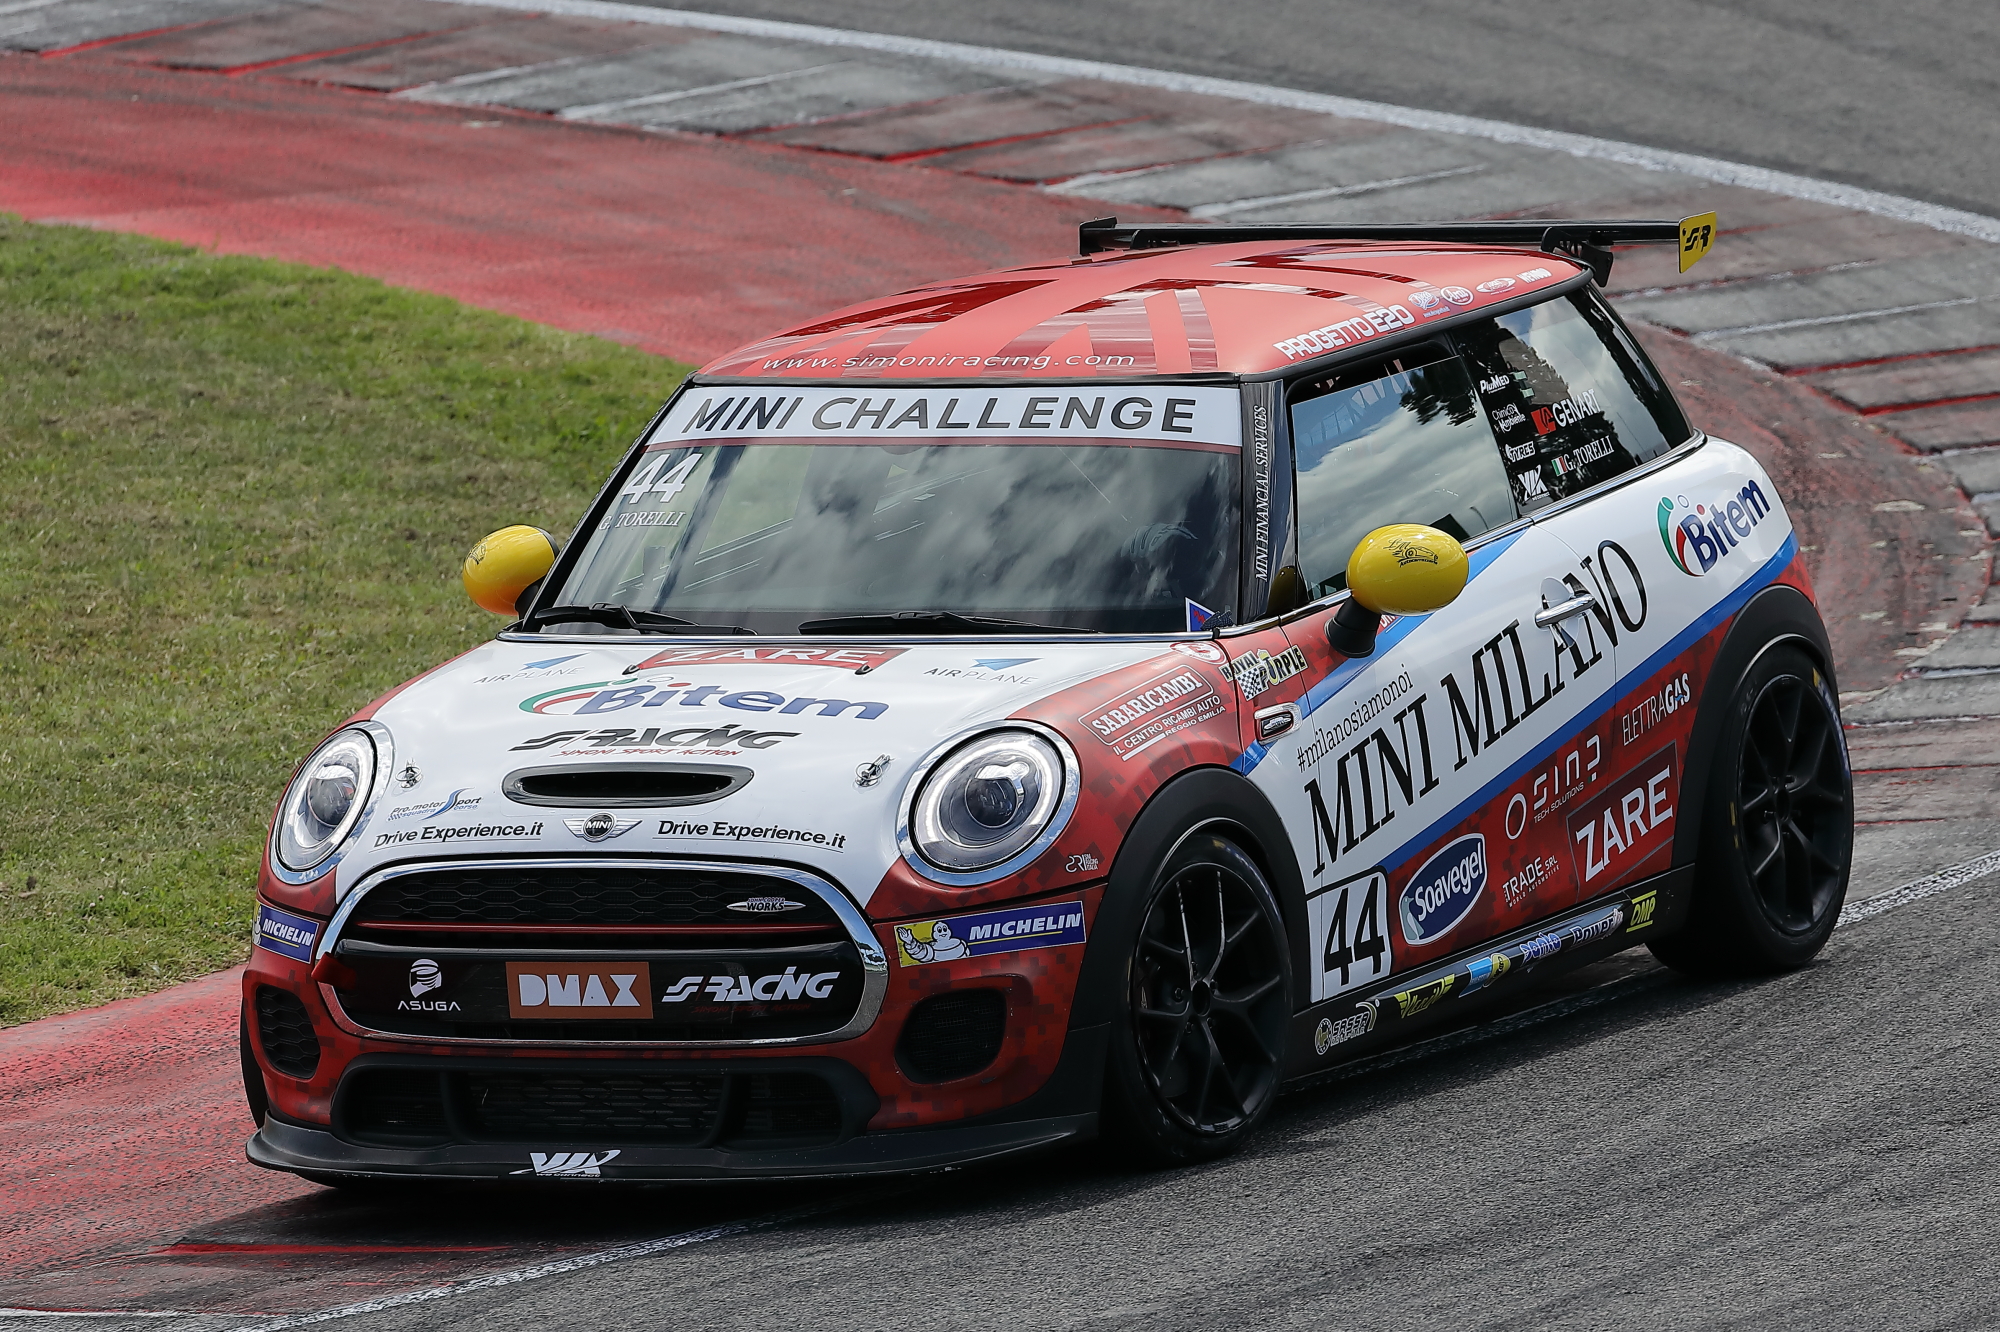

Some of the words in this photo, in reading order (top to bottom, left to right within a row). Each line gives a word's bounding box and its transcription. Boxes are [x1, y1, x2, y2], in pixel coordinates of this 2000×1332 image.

[1273, 317, 1375, 360] PROGETTO
[762, 354, 1135, 371] www.simoniracing.com
[682, 397, 804, 433] MINI
[810, 396, 1196, 434] CHALLENGE
[1254, 405, 1268, 467] SERVICES
[1573, 435, 1615, 467] TORELLI
[621, 453, 703, 504] 44
[615, 511, 687, 529] TORELLI
[1255, 470, 1269, 544] FINANCIAL
[1680, 480, 1771, 574] Bitem
[1255, 547, 1269, 582] MINI
[655, 648, 886, 665] ZARE
[1259, 647, 1306, 690] PURPLE
[574, 682, 890, 720] Bitem
[1091, 672, 1203, 736] SABARICAMBI
[1165, 719, 1197, 736] REGGIO
[1198, 706, 1226, 722] EMILIA
[1297, 664, 1414, 773] #milanosiamonoi
[1304, 692, 1440, 878] MINI
[1440, 540, 1648, 772] MILANO
[1622, 672, 1690, 746] ELETTRAGAS
[1113, 744, 1125, 756] IL
[1124, 722, 1163, 748] CENTRO
[1162, 704, 1198, 728] RICAMBI
[1197, 695, 1220, 714] AUTO
[1534, 805, 1550, 823] TECH
[1550, 781, 1585, 812] SOLUTIONS
[374, 827, 418, 847] Drive
[421, 822, 544, 842] Experience.it
[585, 820, 612, 830] MINI
[658, 820, 709, 836] Drive
[712, 821, 846, 849] Experience.it
[1575, 764, 1673, 883] ZARE
[1414, 841, 1484, 922] Soavegel
[1503, 857, 1544, 900] TRADE
[1544, 855, 1558, 871] SRL
[747, 902, 784, 911] WORKS
[969, 912, 1081, 941] MICHELIN
[262, 918, 314, 946] MICHELIN
[1324, 877, 1386, 987] 44
[397, 1000, 461, 1011] ASUGA
[519, 974, 641, 1006] DMAX
